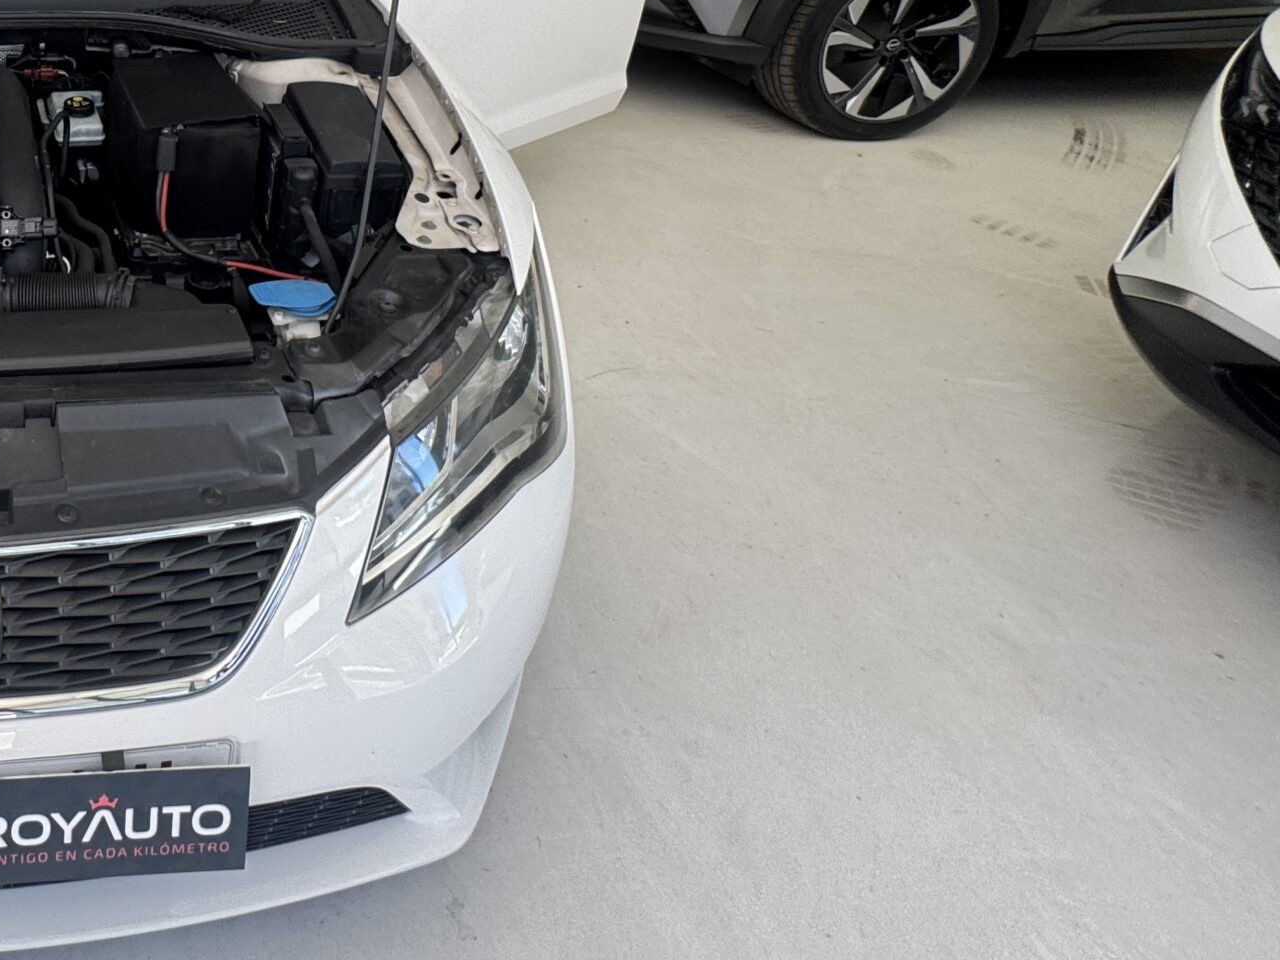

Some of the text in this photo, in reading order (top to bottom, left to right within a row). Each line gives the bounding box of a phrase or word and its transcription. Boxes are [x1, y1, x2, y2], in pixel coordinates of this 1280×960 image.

[56, 850, 77, 862] EN
[83, 847, 128, 860] CADA
[133, 841, 230, 857] KILÓMETRO
